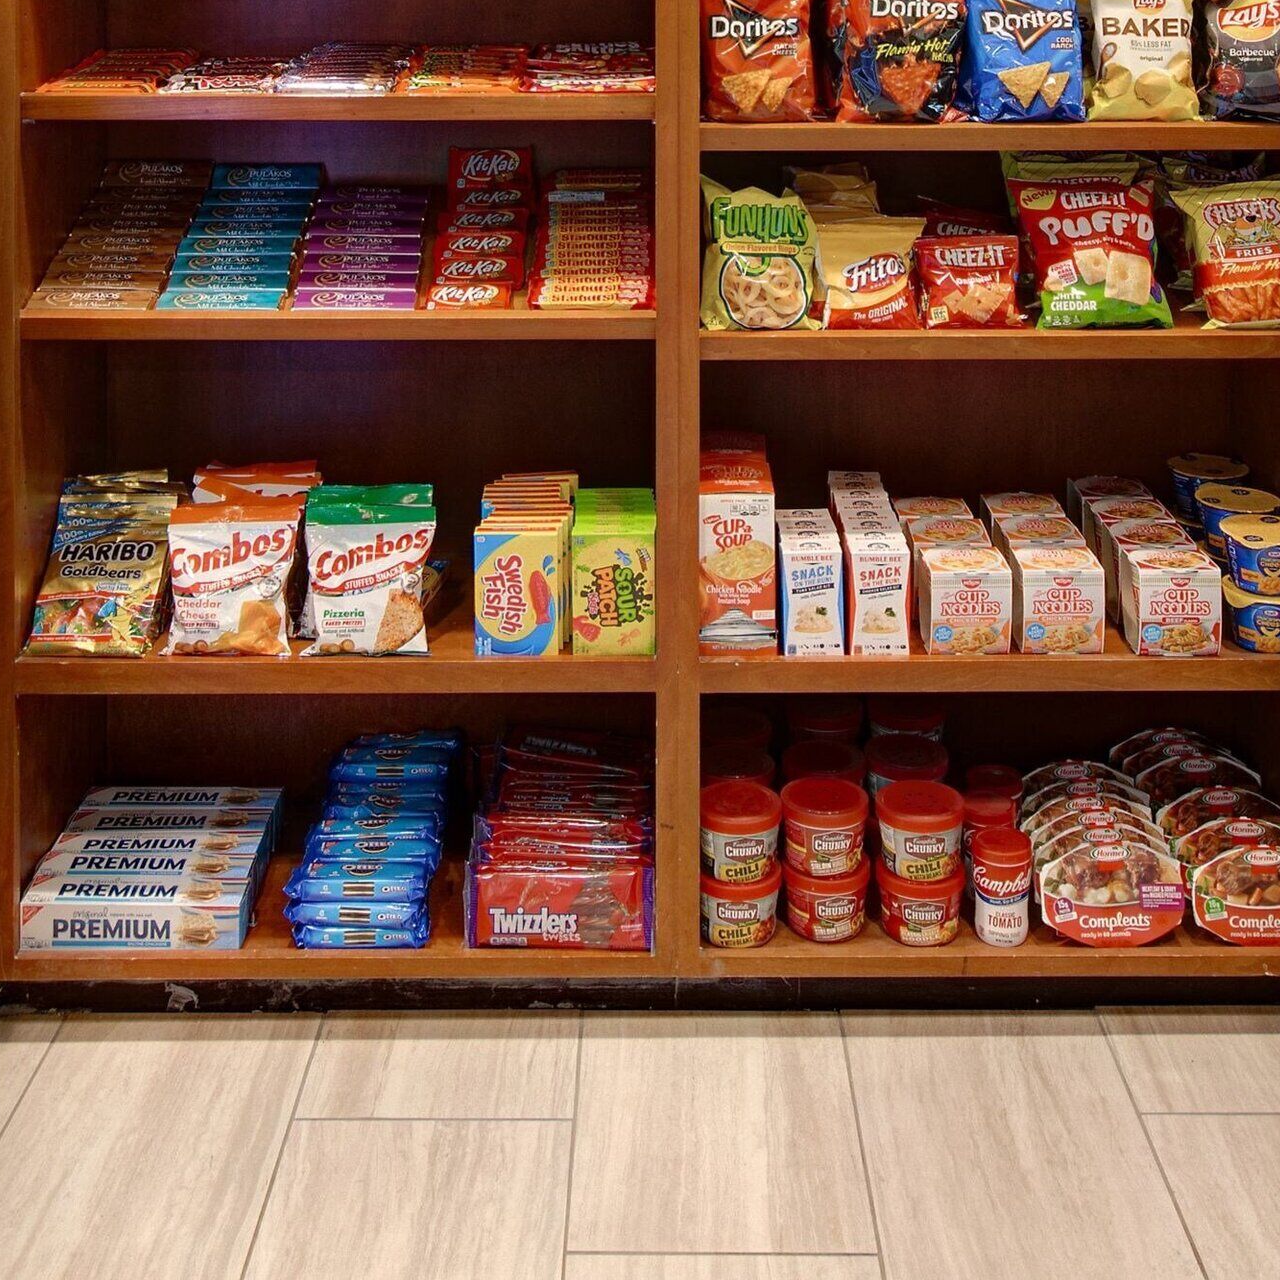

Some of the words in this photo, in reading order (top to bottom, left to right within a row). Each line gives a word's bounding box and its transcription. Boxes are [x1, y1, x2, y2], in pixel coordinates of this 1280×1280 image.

[711, 16, 799, 38] Doritos
[984, 9, 1073, 39] Doritos
[1102, 18, 1190, 37] BAKED
[1229, 48, 1275, 57] Barbecue
[747, 244, 776, 252] Flavored
[776, 245, 797, 254] Rings
[1236, 247, 1273, 257] FRIES
[842, 256, 906, 292] Fritos
[71, 292, 121, 301] PULAKOS
[197, 292, 248, 301] PULAKOS
[1051, 300, 1097, 311] CHEDDAR
[853, 310, 867, 320] The
[62, 542, 155, 562] HARIBO
[171, 528, 286, 578] Combos
[316, 529, 430, 581] Combos
[61, 566, 142, 579] Goldbears
[792, 565, 834, 581] SNACK
[860, 566, 902, 581] SNACK
[344, 575, 376, 590] STUFFED
[736, 584, 763, 594] Noodle
[484, 575, 506, 618] Fish
[497, 554, 527, 634] Swedish
[593, 567, 619, 626] PATCH
[615, 567, 637, 622] SOUR
[955, 591, 989, 603] CUP
[1047, 589, 1081, 601] CUP
[1164, 589, 1199, 602] CUP
[176, 600, 222, 609] Cheddar
[941, 601, 1001, 616] NOODLES
[1033, 600, 1094, 615] NOODLES
[1150, 600, 1211, 615] NOODLES
[179, 610, 217, 619] Cheese
[323, 609, 365, 619] Pizzeria
[111, 792, 219, 802] PREMIUM
[97, 815, 207, 827] PREMIUM
[1085, 830, 1119, 842] Hormel
[1227, 824, 1263, 836] Hormel
[83, 839, 196, 850] PREMIUM
[726, 844, 763, 857] CHUNKY
[814, 840, 851, 851] CHUNKY
[906, 843, 944, 854] CHUNKY
[1092, 847, 1129, 858] Hormel
[70, 856, 186, 870] PREMIUM
[906, 862, 941, 874] CHILI
[726, 863, 759, 877] CHILI
[58, 884, 178, 897] PREMIUM
[73, 907, 107, 920] original
[718, 907, 757, 920] CHUNKY
[818, 904, 854, 916] CHUNKY
[905, 909, 943, 921] CHUNKY
[489, 907, 579, 935] Twizzlers
[988, 915, 1022, 928] TOMATO
[1079, 915, 1151, 931] Compleats
[52, 919, 171, 940] PREMIUM
[718, 928, 752, 939] CHILI
[1110, 930, 1132, 938] seconds
[542, 932, 581, 942] twists
